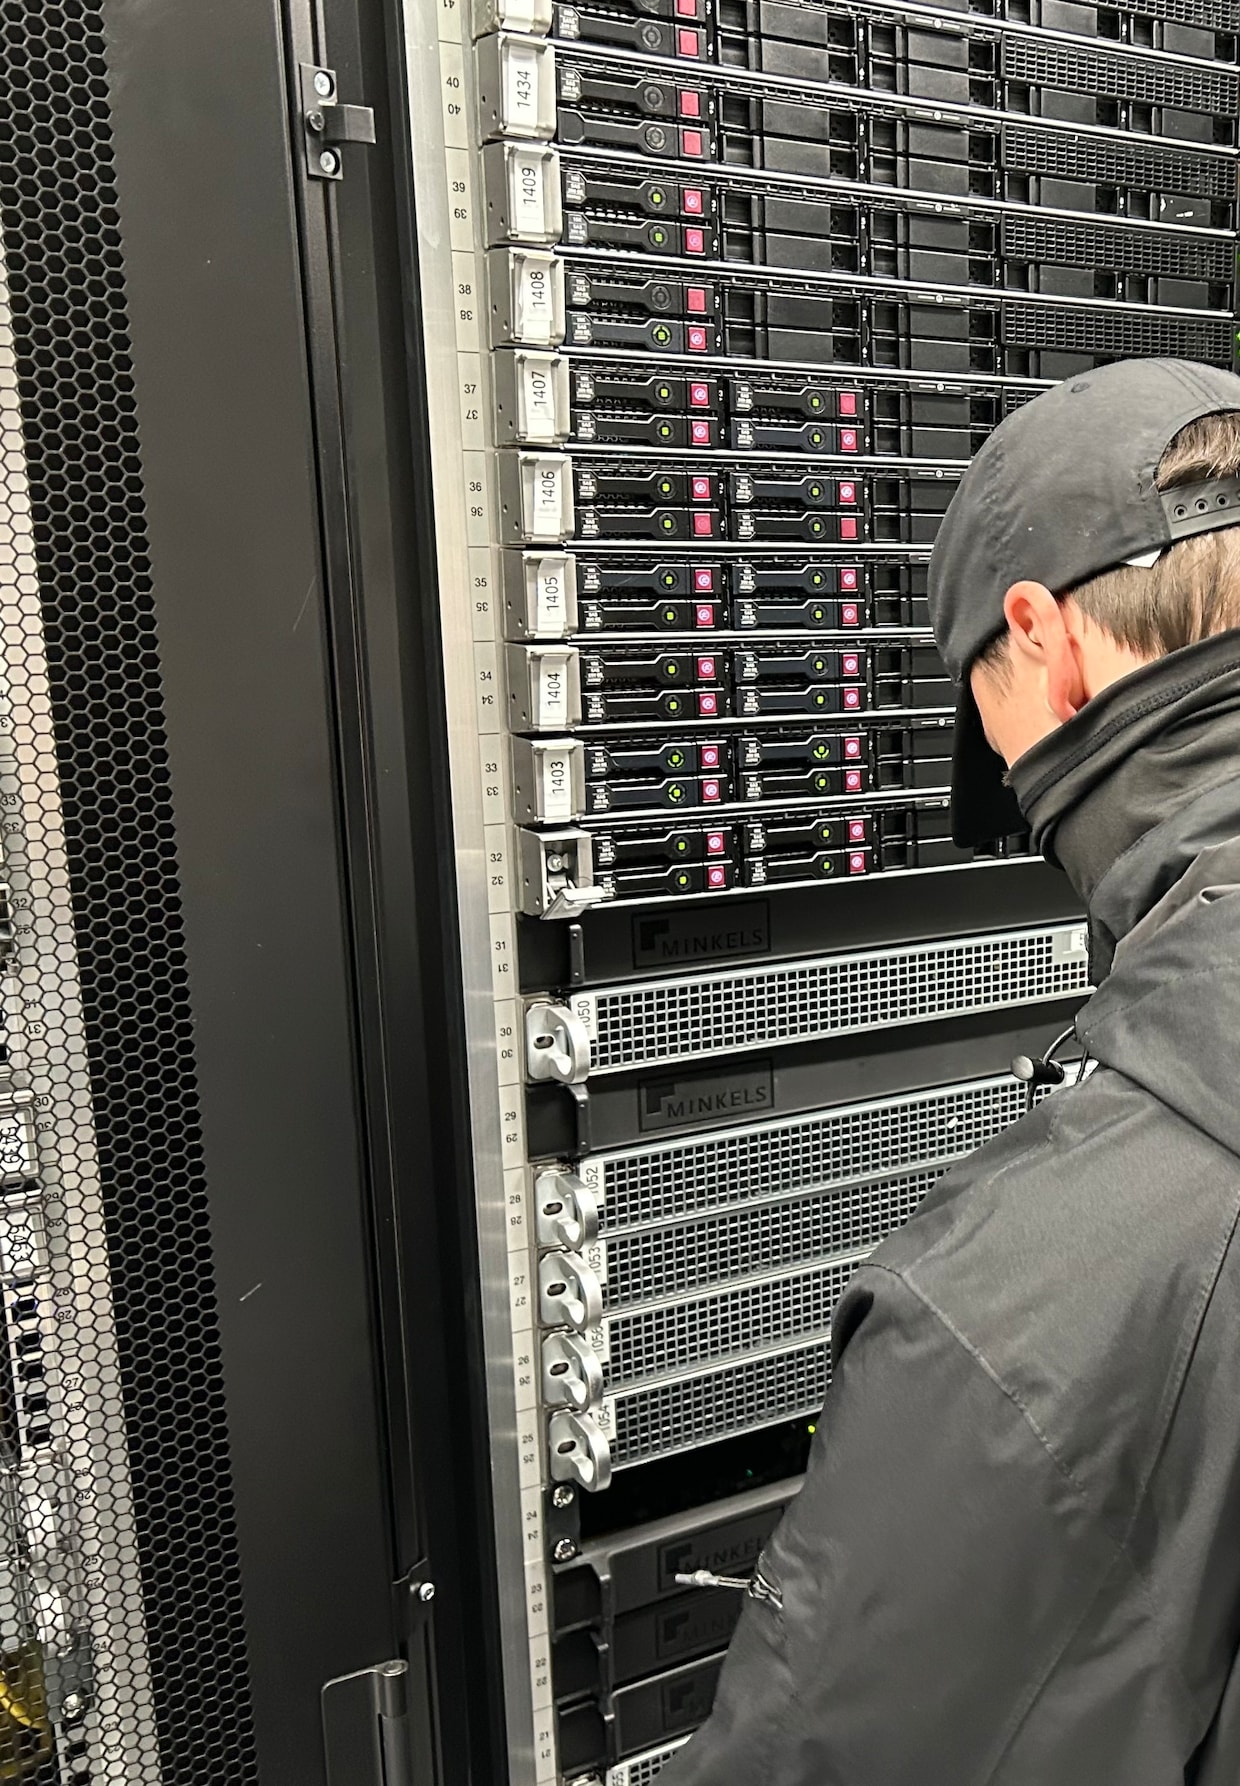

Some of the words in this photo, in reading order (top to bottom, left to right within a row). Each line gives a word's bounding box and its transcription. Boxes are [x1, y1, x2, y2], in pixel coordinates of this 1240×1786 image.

[443, 0, 455, 9] 41
[446, 76, 460, 89] 40
[516, 70, 532, 107] 1434
[447, 103, 461, 115] 40
[452, 181, 466, 193] 39
[521, 167, 537, 204] 1409
[453, 207, 467, 220] 39
[458, 283, 472, 295] 38
[529, 270, 546, 307] 1408
[459, 309, 473, 321] 38
[464, 383, 477, 395] 37
[531, 370, 547, 406] 1407
[465, 409, 479, 420] 37
[469, 481, 482, 492] 36
[540, 470, 556, 505] 1406
[470, 506, 484, 517] 36
[474, 577, 488, 588] 35
[544, 576, 560, 611] 1405
[475, 601, 489, 612] 35
[479, 671, 492, 681] 34
[546, 672, 561, 706] 1404
[481, 694, 494, 705] 34
[485, 762, 498, 773] 33
[549, 760, 565, 794] 1403
[486, 786, 499, 797] 33
[490, 852, 503, 863] 32
[491, 875, 504, 886] 32
[495, 940, 506, 951] 31
[663, 928, 763, 958] MINKELS
[498, 963, 509, 973] 31
[500, 1026, 513, 1037] 30
[501, 1048, 513, 1060] 30
[667, 1085, 767, 1118] MINKELS
[504, 1111, 517, 1122] 29
[505, 1132, 518, 1144] 29
[509, 1194, 522, 1205] 28
[510, 1215, 523, 1226] 28
[684, 1537, 764, 1571] MINKEL
